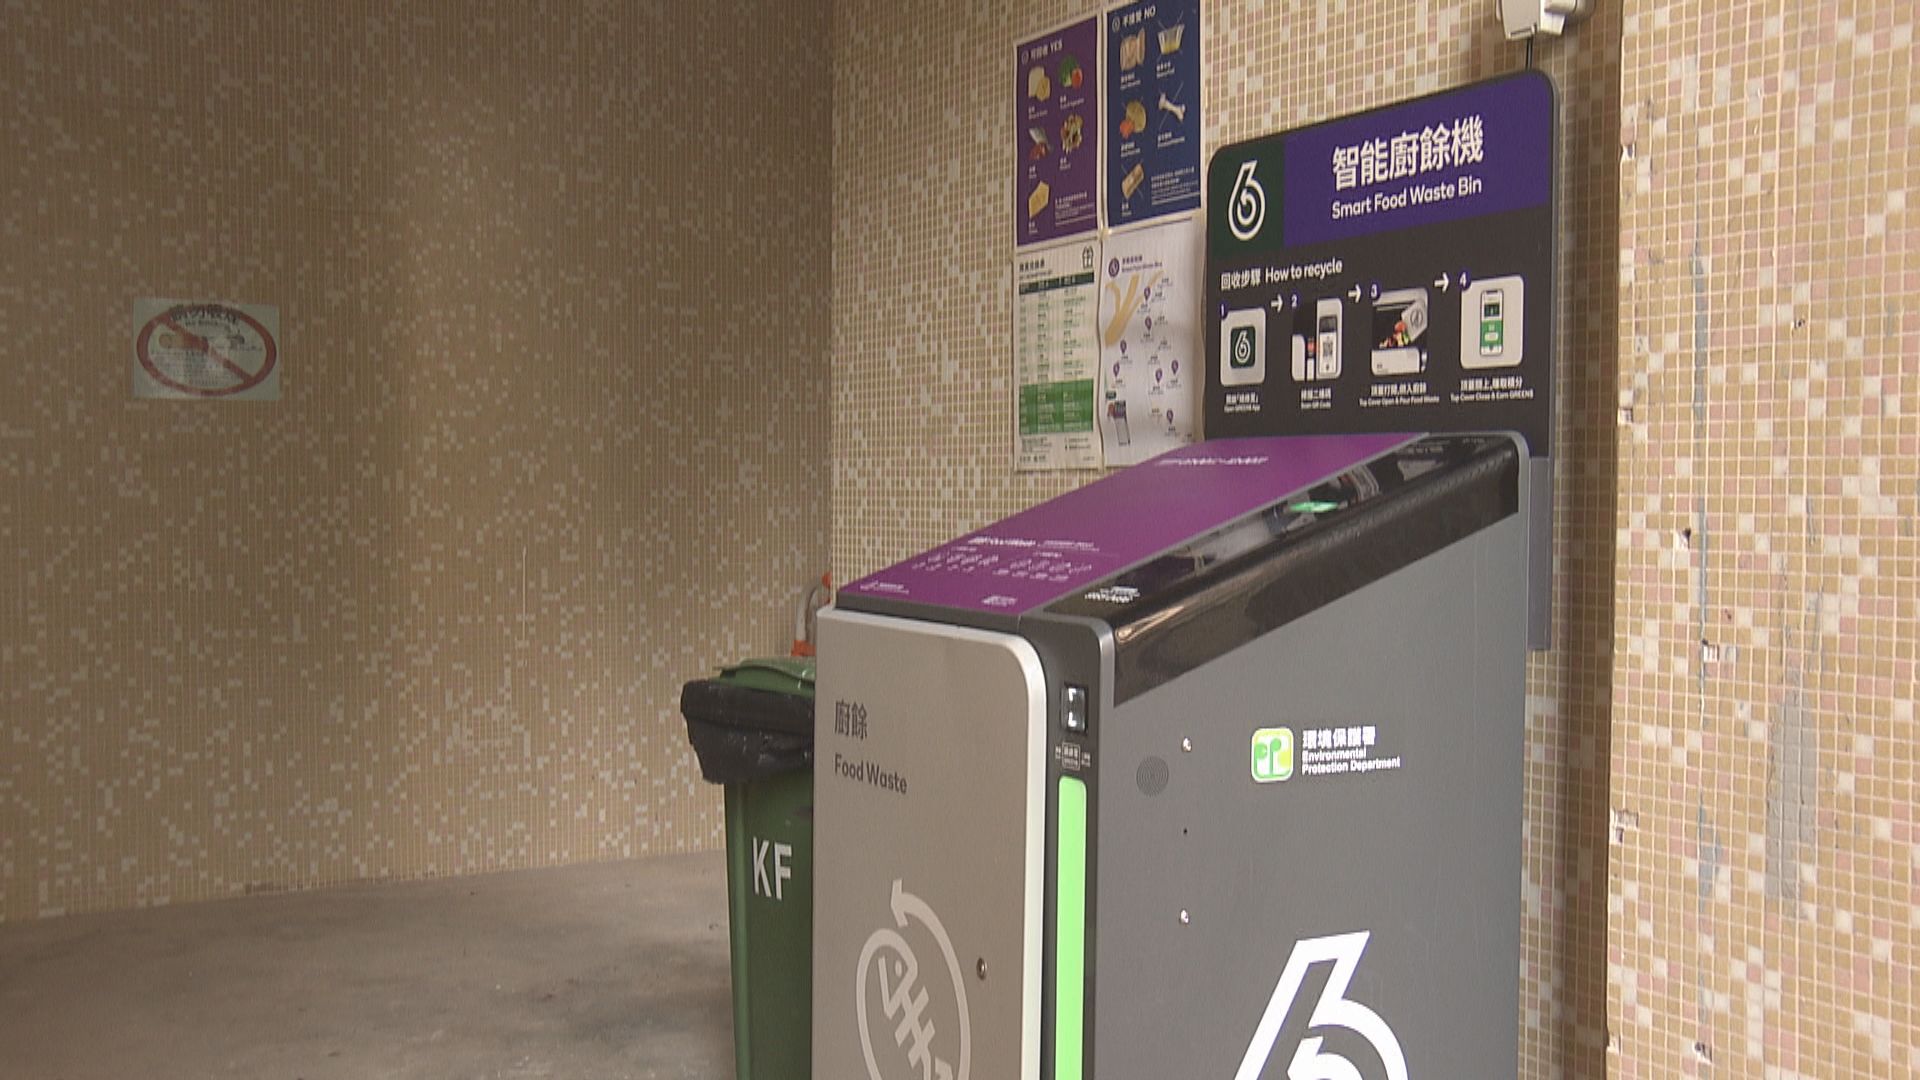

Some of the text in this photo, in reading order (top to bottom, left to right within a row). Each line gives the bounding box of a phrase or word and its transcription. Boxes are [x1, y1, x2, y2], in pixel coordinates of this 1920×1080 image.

[1332, 114, 1484, 191] 智能廚餘機
[1332, 175, 1482, 219] Smart Food Waste Bin
[1265, 267, 1289, 284] How
[1291, 264, 1302, 279] to
[1304, 257, 1342, 280] recycle
[1459, 272, 1467, 286] 4
[834, 699, 867, 739] 廚餘
[834, 753, 907, 794] Food Waste
[1302, 747, 1366, 763] Environmental
[1302, 756, 1400, 775] Protection Department
[752, 837, 792, 900] KF
